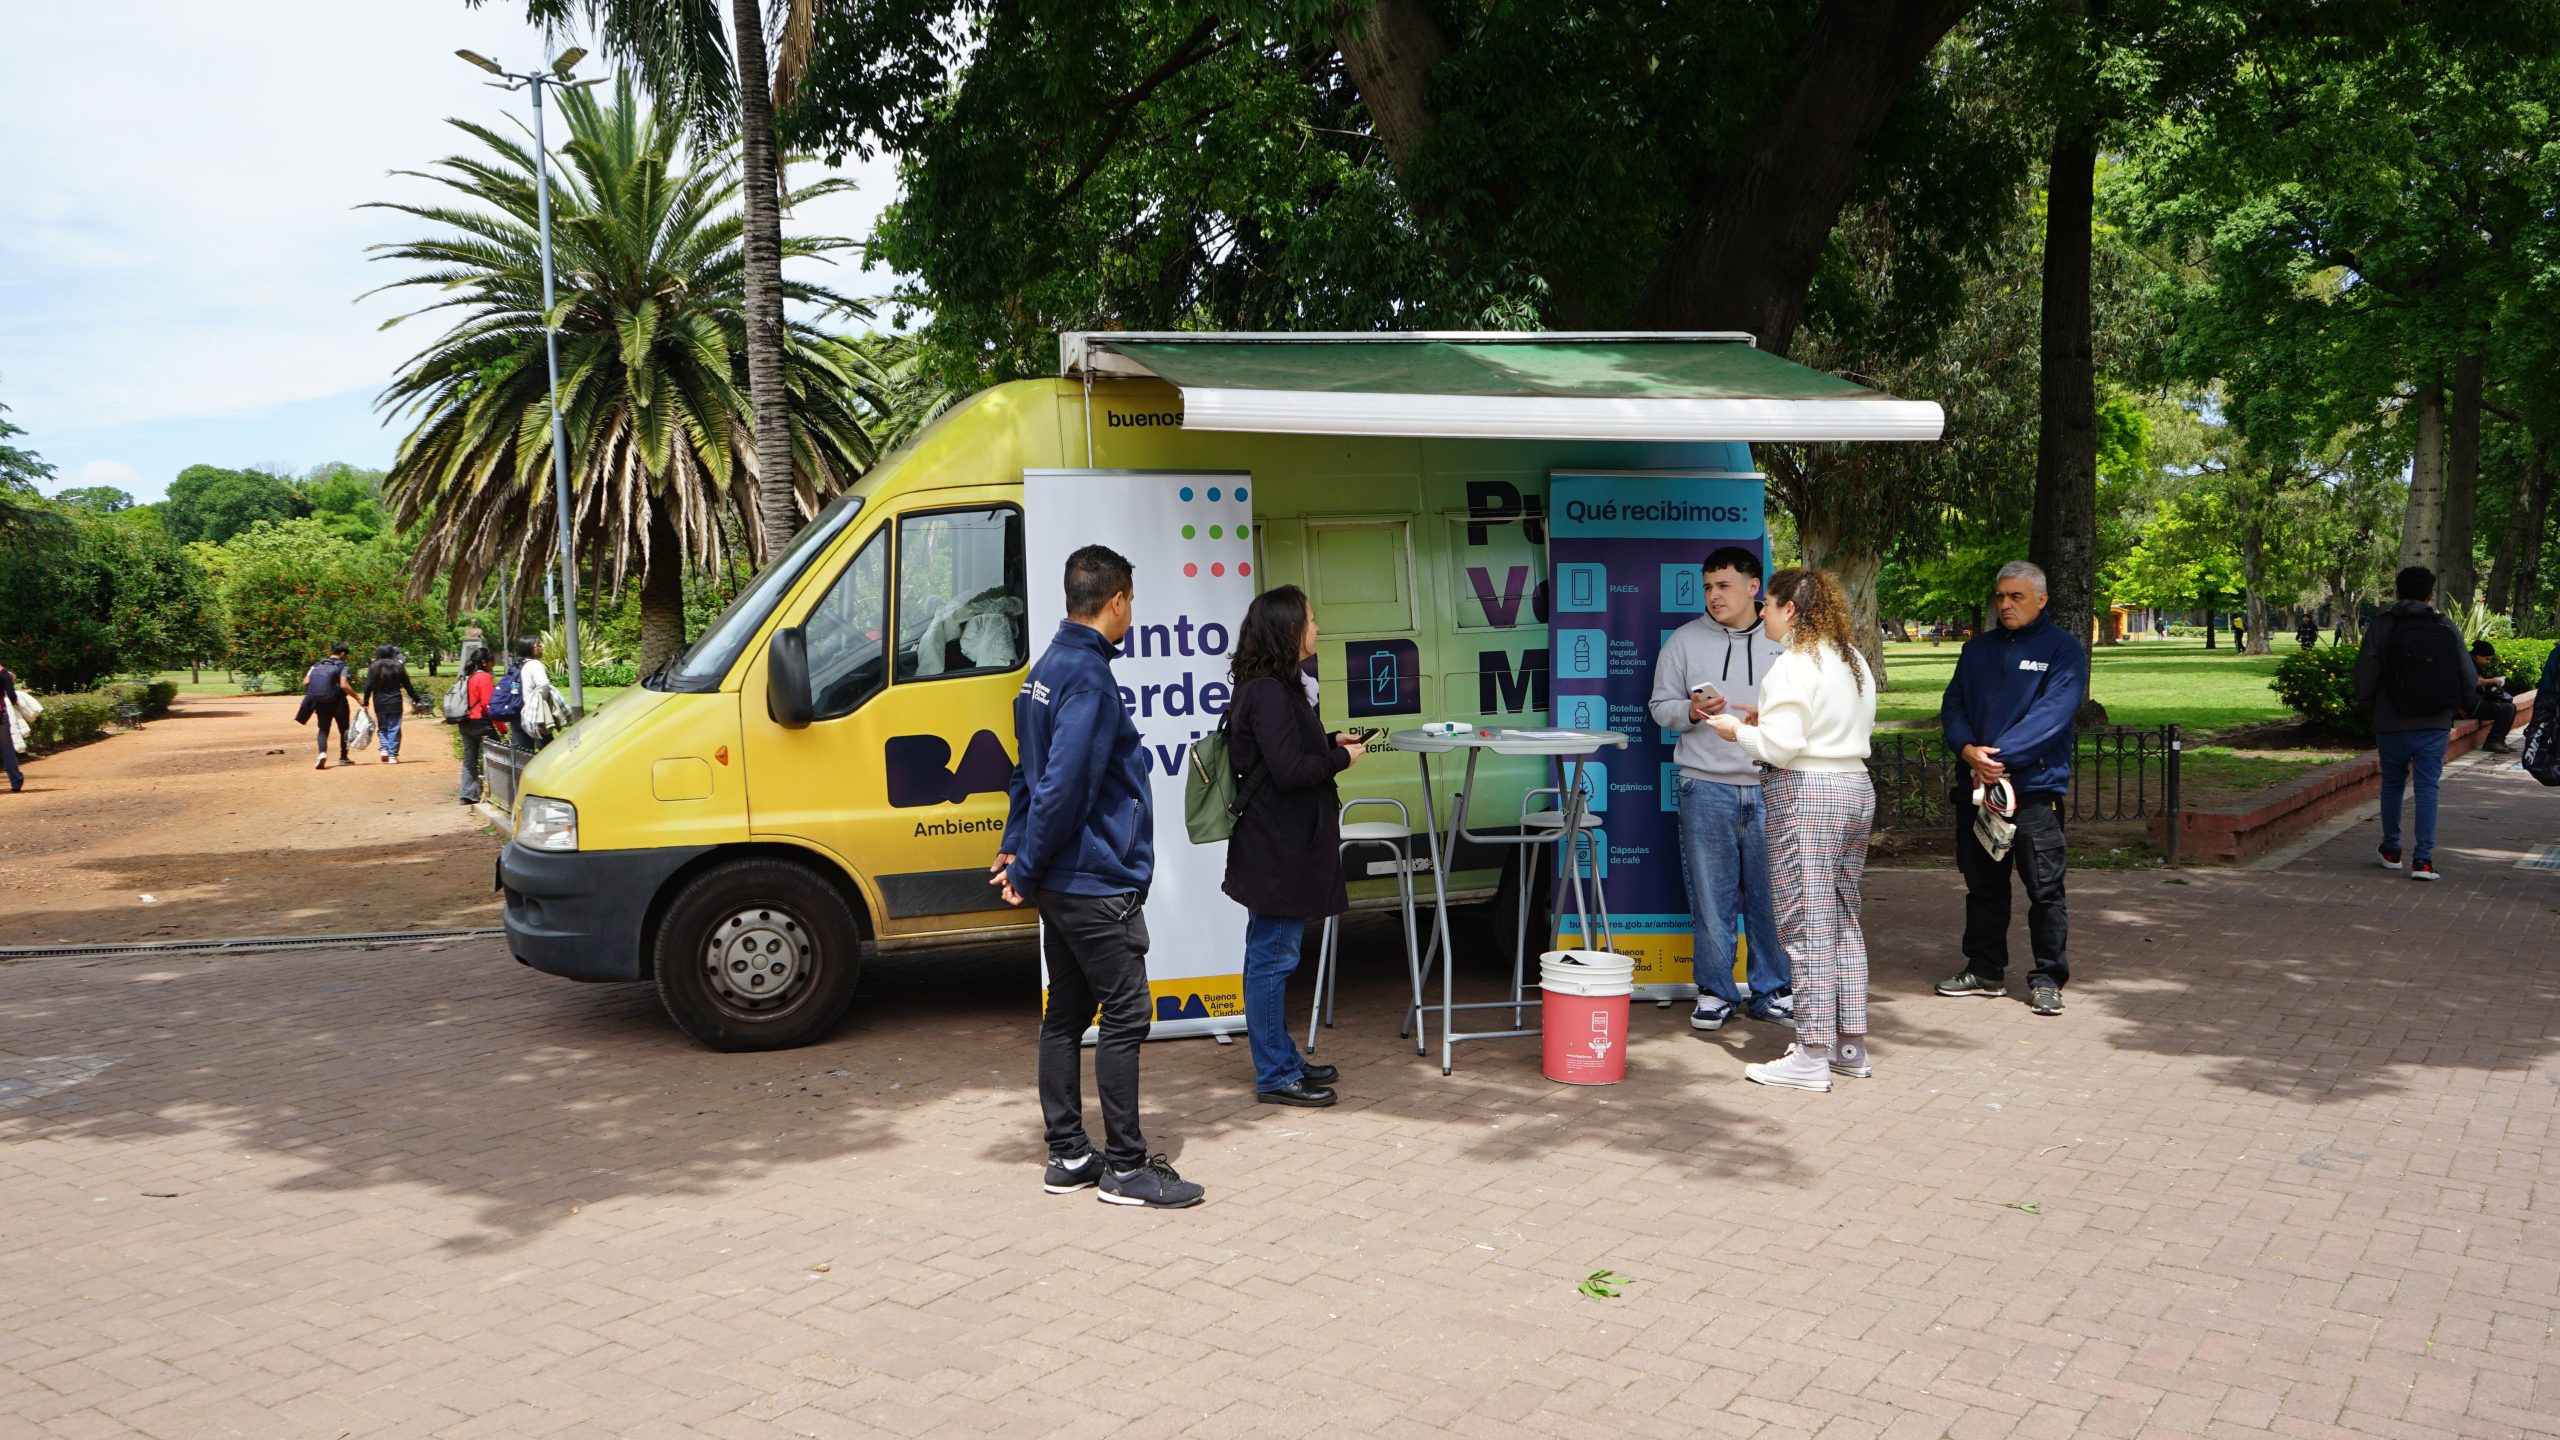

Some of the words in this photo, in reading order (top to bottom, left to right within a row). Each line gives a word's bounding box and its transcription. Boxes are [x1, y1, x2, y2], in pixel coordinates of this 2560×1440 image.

[1108, 410, 1184, 427] buenos
[1466, 480, 1549, 546] Pu
[1566, 500, 1617, 523] Qué
[1622, 500, 1748, 523] recibimos:
[1610, 585, 1639, 593] RAEEs
[1113, 615, 1229, 659] unto
[1610, 650, 1638, 658] vegetal
[1118, 672, 1231, 718] erde
[1610, 704, 1644, 713] Botellas
[1382, 727, 1390, 738] y
[1610, 783, 1653, 792] Orgánicos
[914, 818, 1004, 837] Ambiente
[1610, 846, 1650, 855] Cápsulas
[1610, 856, 1621, 864] de
[1622, 856, 1641, 864] café
[1204, 993, 1237, 1003] Buenos
[1210, 1002, 1235, 1010] Aires
[1213, 1008, 1245, 1018] Ciudad
